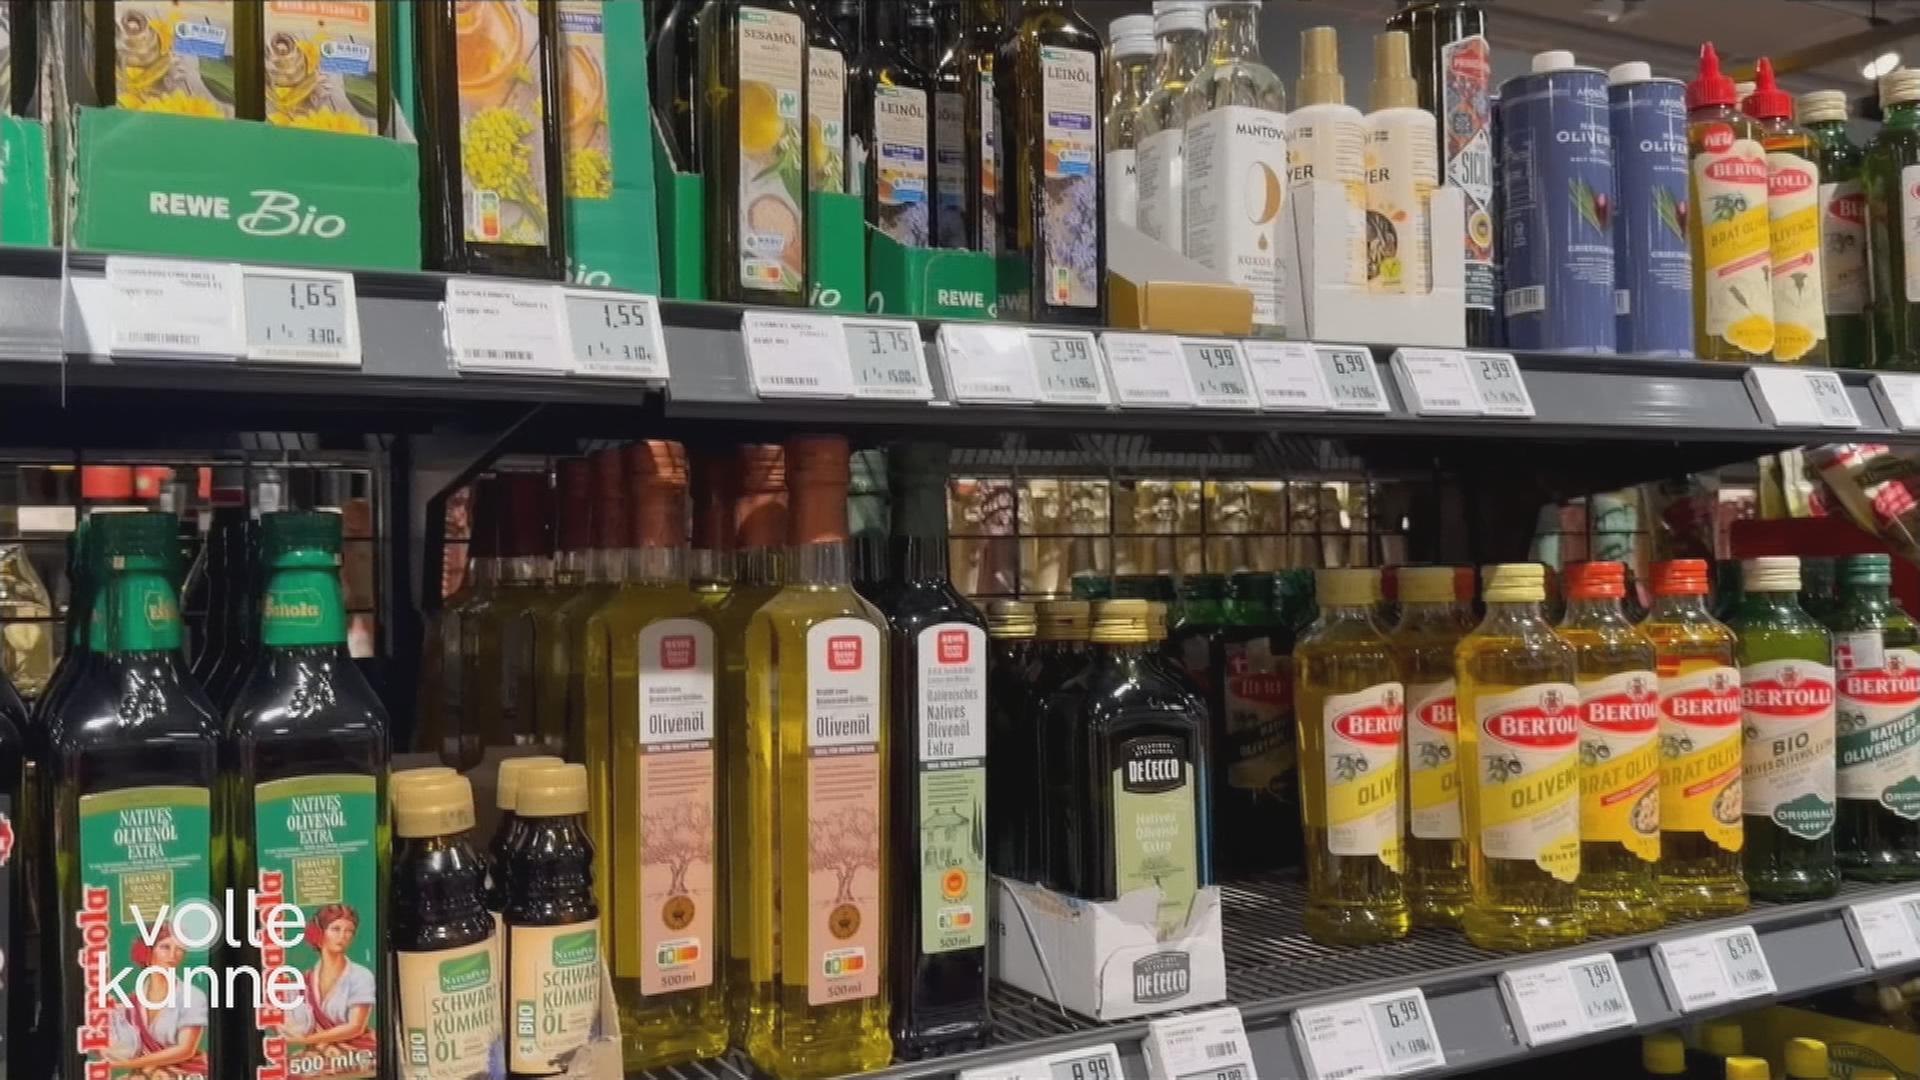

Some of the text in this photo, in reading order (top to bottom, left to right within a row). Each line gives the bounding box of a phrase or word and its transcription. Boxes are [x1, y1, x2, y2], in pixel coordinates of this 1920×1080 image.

[744, 28, 797, 45] SESAMÖL
[1047, 65, 1093, 84] LEINÖL
[881, 100, 925, 119] LEINÖL
[1769, 175, 1809, 189] TOLLI
[149, 189, 346, 239] REWE Bio
[575, 263, 612, 286] io
[937, 288, 985, 308] REWE
[1741, 688, 1832, 707] BERTOLLI
[649, 711, 705, 735] Olivenöl
[928, 704, 966, 721] Natives
[816, 712, 871, 738] Olivenöl
[1869, 713, 1917, 743] NATIVES
[1773, 732, 1810, 757] BIO
[1844, 736, 1903, 766] OLIVENÖL
[292, 794, 342, 814] NATIVES
[120, 807, 173, 827] NATIVES
[287, 810, 346, 832] OLIVENÖL
[114, 820, 178, 846] OLIVENÖL
[299, 829, 334, 845] EXTRA
[128, 843, 165, 860] EXTRA
[519, 1004, 534, 1035] BIO
[543, 1009, 567, 1035] ÖL
[411, 1032, 427, 1063] BIO
[436, 1034, 462, 1062] ÖL
[289, 1056, 325, 1075] 500
